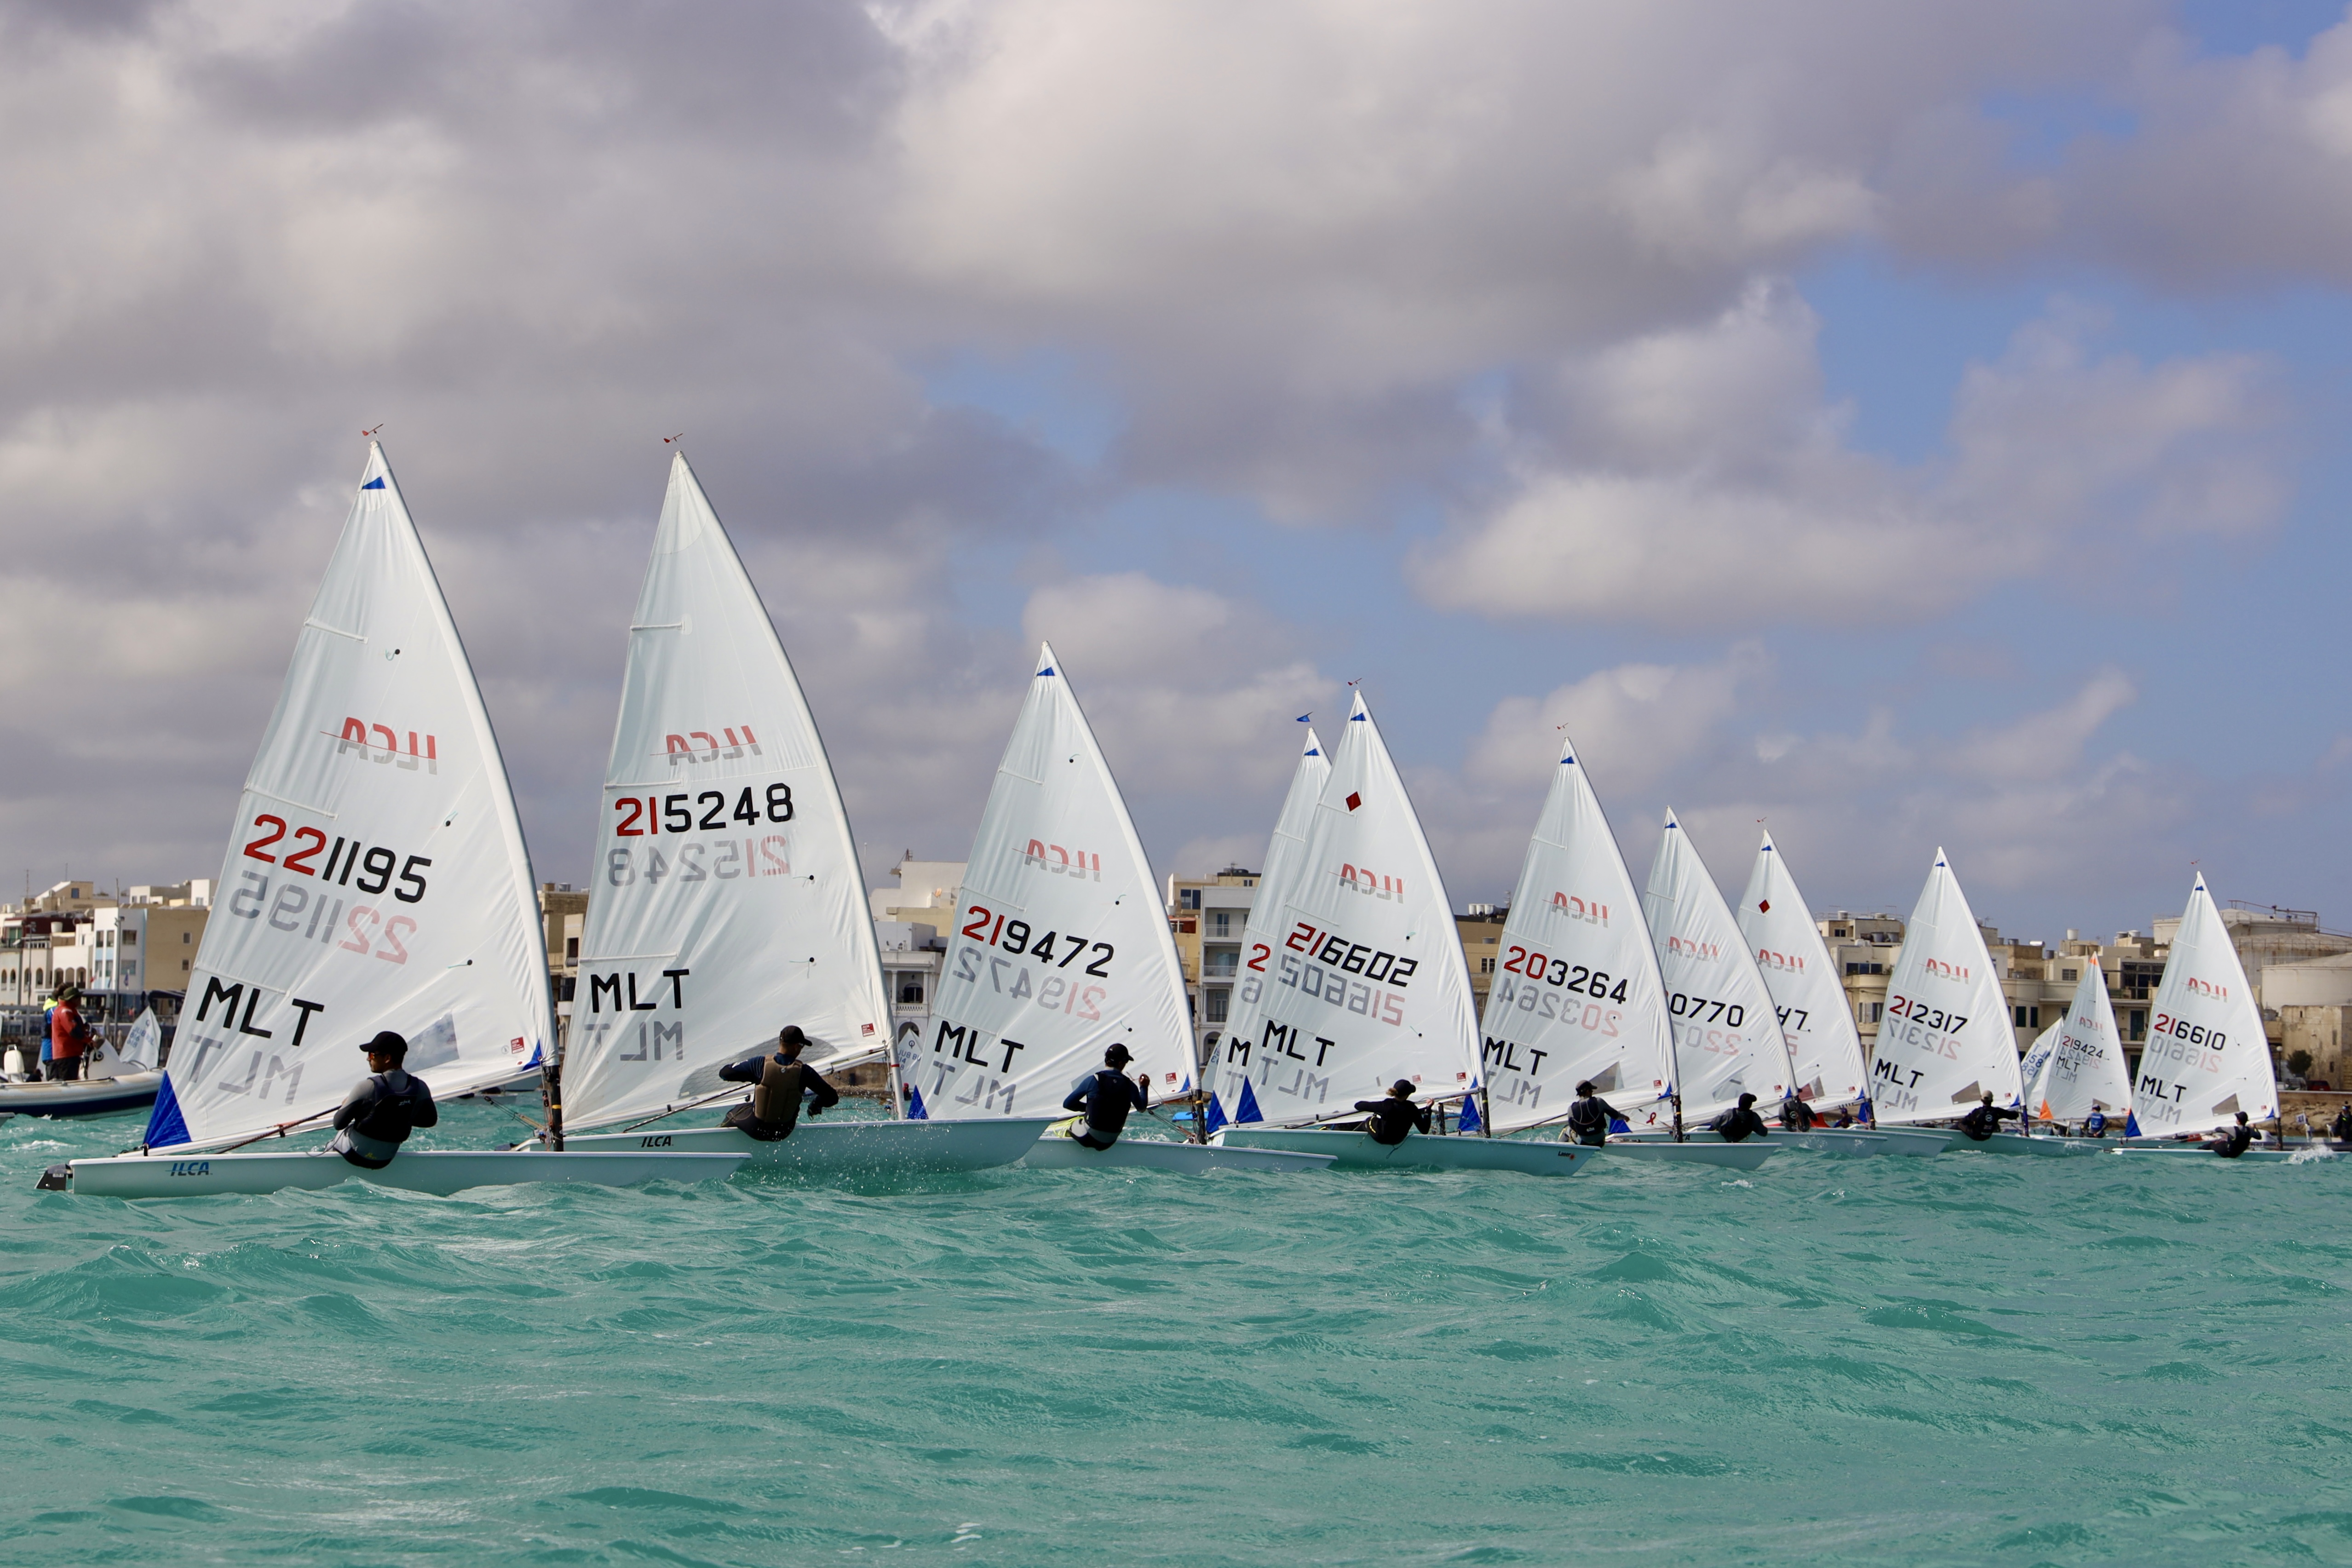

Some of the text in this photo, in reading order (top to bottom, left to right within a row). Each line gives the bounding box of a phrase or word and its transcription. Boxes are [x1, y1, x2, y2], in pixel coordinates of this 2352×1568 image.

[615, 782, 794, 837] 215248
[243, 814, 432, 903] 221195
[961, 905, 1114, 978] 219472
[1285, 922, 1418, 987] 216602
[590, 969, 690, 1013] MLT
[1503, 945, 1628, 1005] 203264
[196, 976, 324, 1046] MLT
[1664, 990, 1744, 1028] 0770
[1889, 995, 1967, 1034] 212317
[935, 1020, 1024, 1073] MLT
[1261, 1019, 1335, 1067] MLT
[2062, 1035, 2104, 1059] 219424
[2154, 1013, 2226, 1051] 216610
[1484, 1036, 1547, 1075] MLT
[1875, 1058, 1924, 1089] MLT
[2056, 1056, 2081, 1073] MLT
[2141, 1075, 2187, 1103] MLT
[641, 1136, 672, 1148] ILCA
[170, 1161, 210, 1177] ILCA
